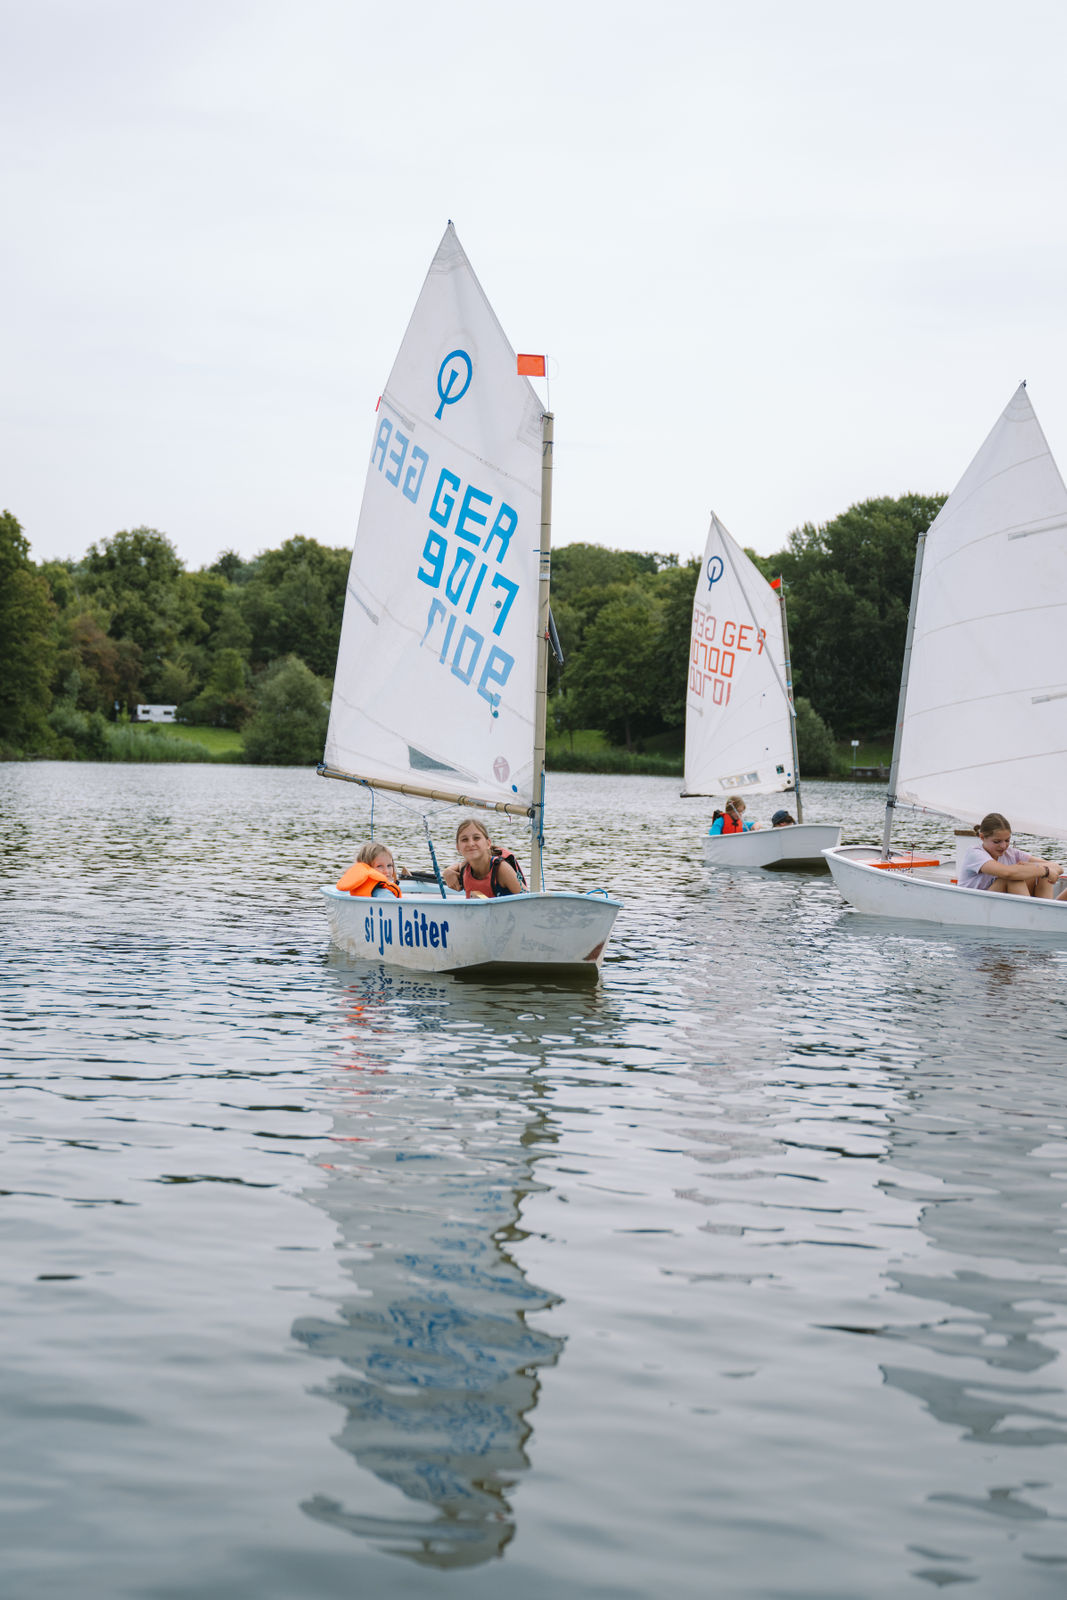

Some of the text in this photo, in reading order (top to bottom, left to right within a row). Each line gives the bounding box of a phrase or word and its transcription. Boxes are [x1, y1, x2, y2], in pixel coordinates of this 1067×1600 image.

[429, 467, 518, 564] GER
[417, 529, 520, 637] 9017
[364, 906, 449, 956] si ju laiter
